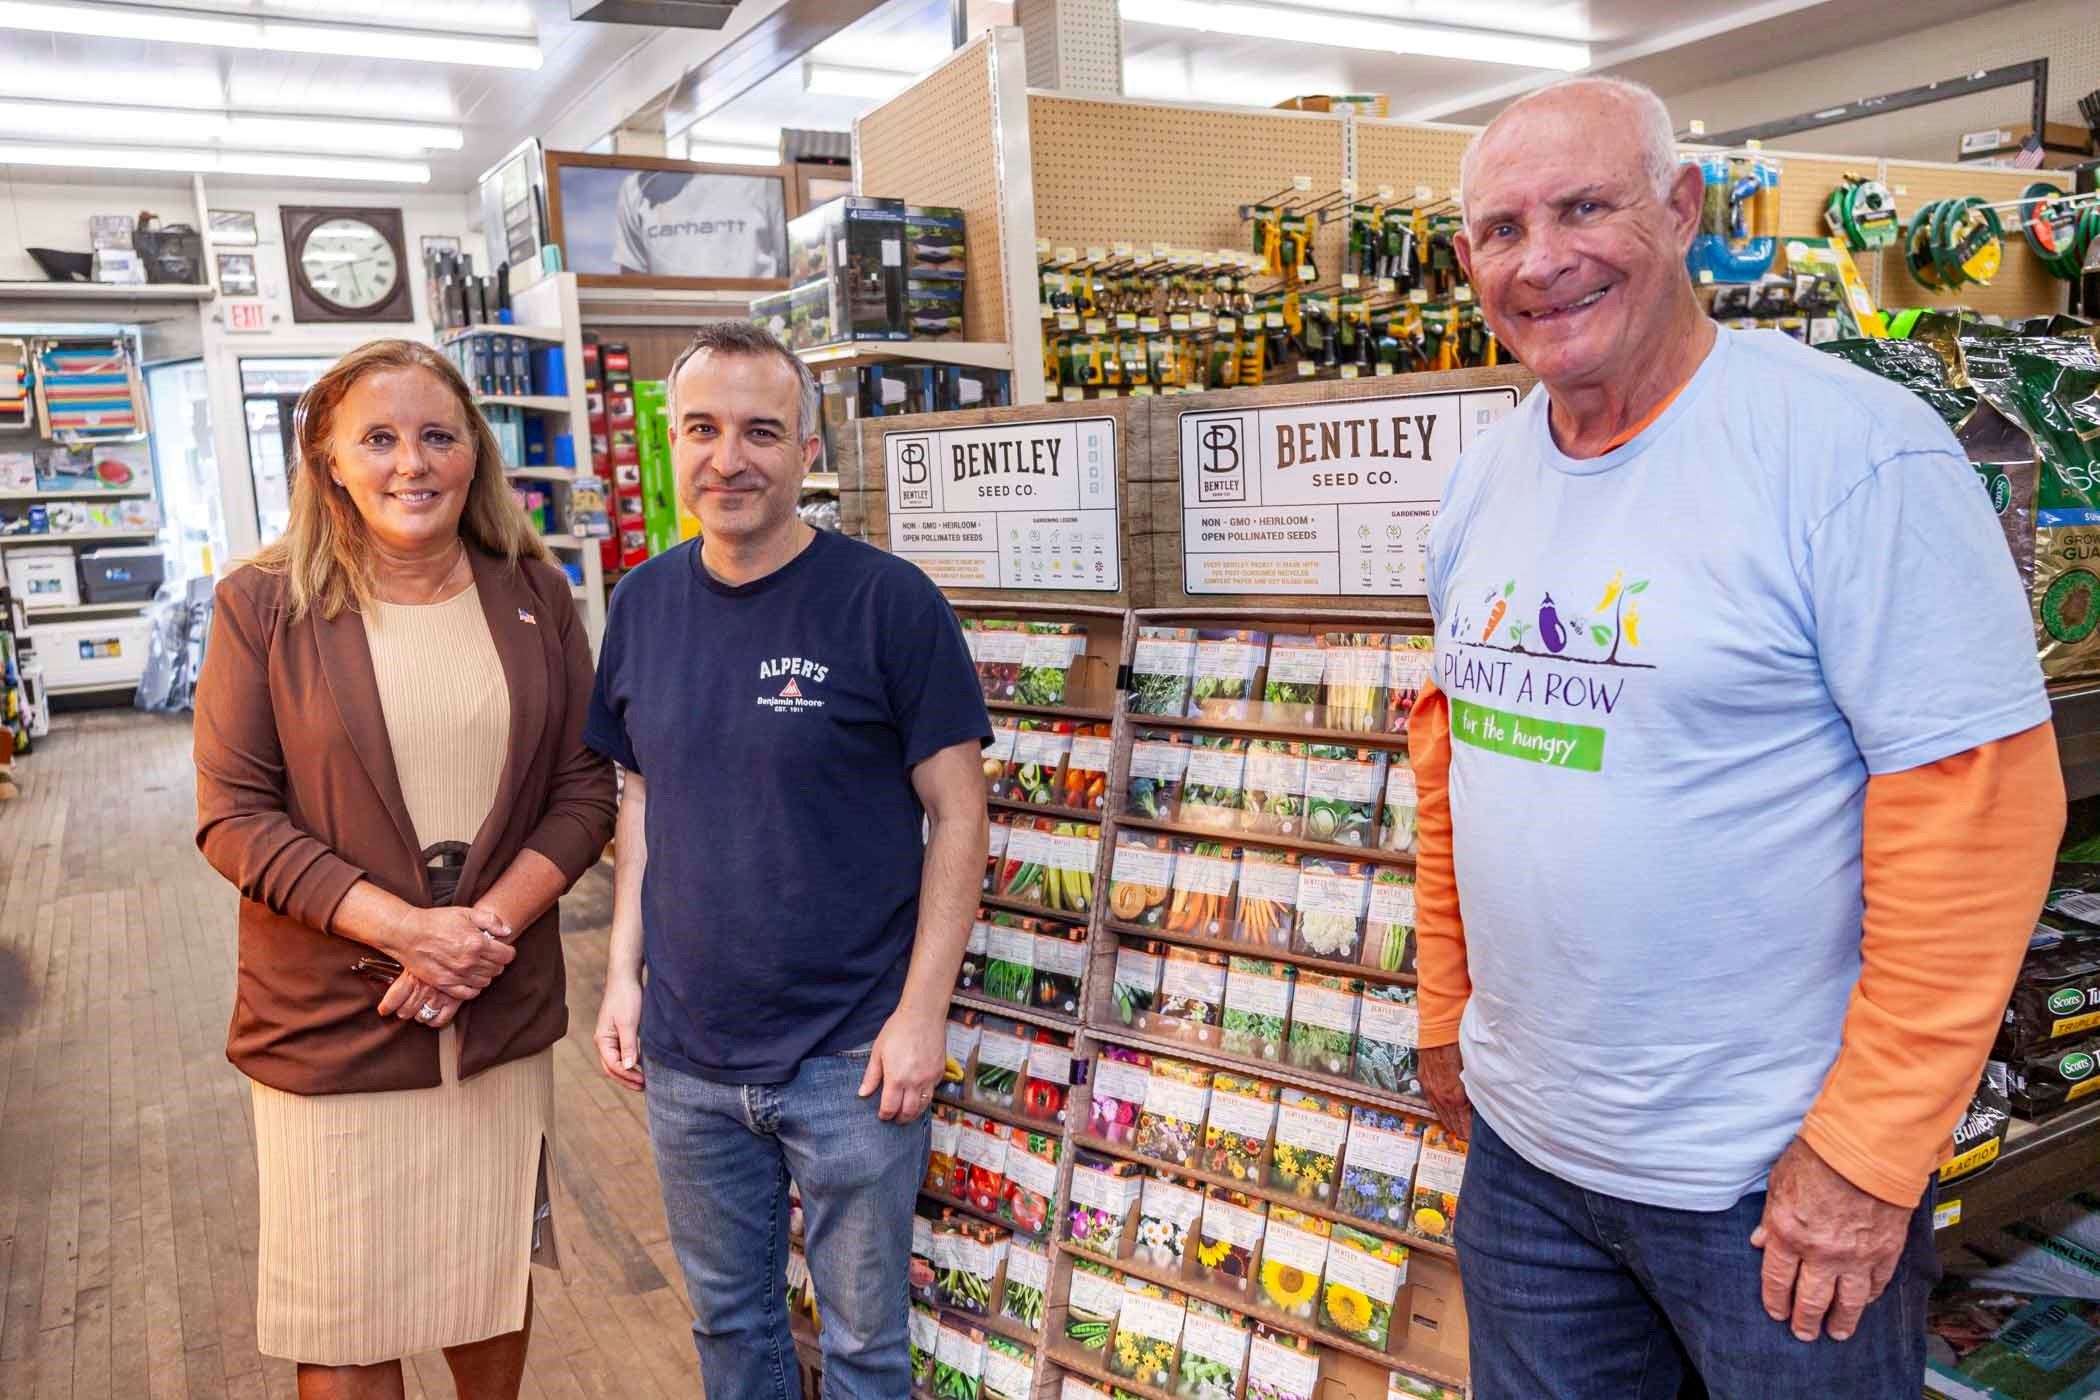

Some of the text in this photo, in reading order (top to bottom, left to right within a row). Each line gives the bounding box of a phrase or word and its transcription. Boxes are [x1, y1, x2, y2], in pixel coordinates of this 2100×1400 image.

[648, 219, 747, 238] carhartt
[231, 303, 265, 328] EXIT
[1276, 414, 1437, 470] BENTLEY
[951, 438, 1062, 482] BENTLEY
[1204, 479, 1240, 493] BENTLEY
[1312, 470, 1398, 488] SEED CO.
[903, 490, 928, 501] BENTLEY
[978, 484, 1038, 498] SEED CO.
[1201, 517, 1221, 527] NON
[1229, 517, 1251, 527] GMO
[1258, 516, 1309, 526] HEIRLOOM
[1391, 510, 1431, 518] GARDENING
[902, 521, 917, 530] NON
[942, 521, 977, 529] HEIRLOOM
[902, 532, 984, 543] OPEN POLLINATED SEEDS
[1201, 530, 1317, 542] OPEN POLLINATED SEEDS
[760, 657, 829, 682] ALPER'S
[1444, 653, 1624, 714] PLANT A ROW
[757, 696, 823, 707] Benjamin Moore
[1462, 709, 1577, 765] for the hungry
[2053, 996, 2082, 1009] Scotts
[2064, 1058, 2090, 1074] Scotts
[1958, 1144, 1998, 1169] ACTION
